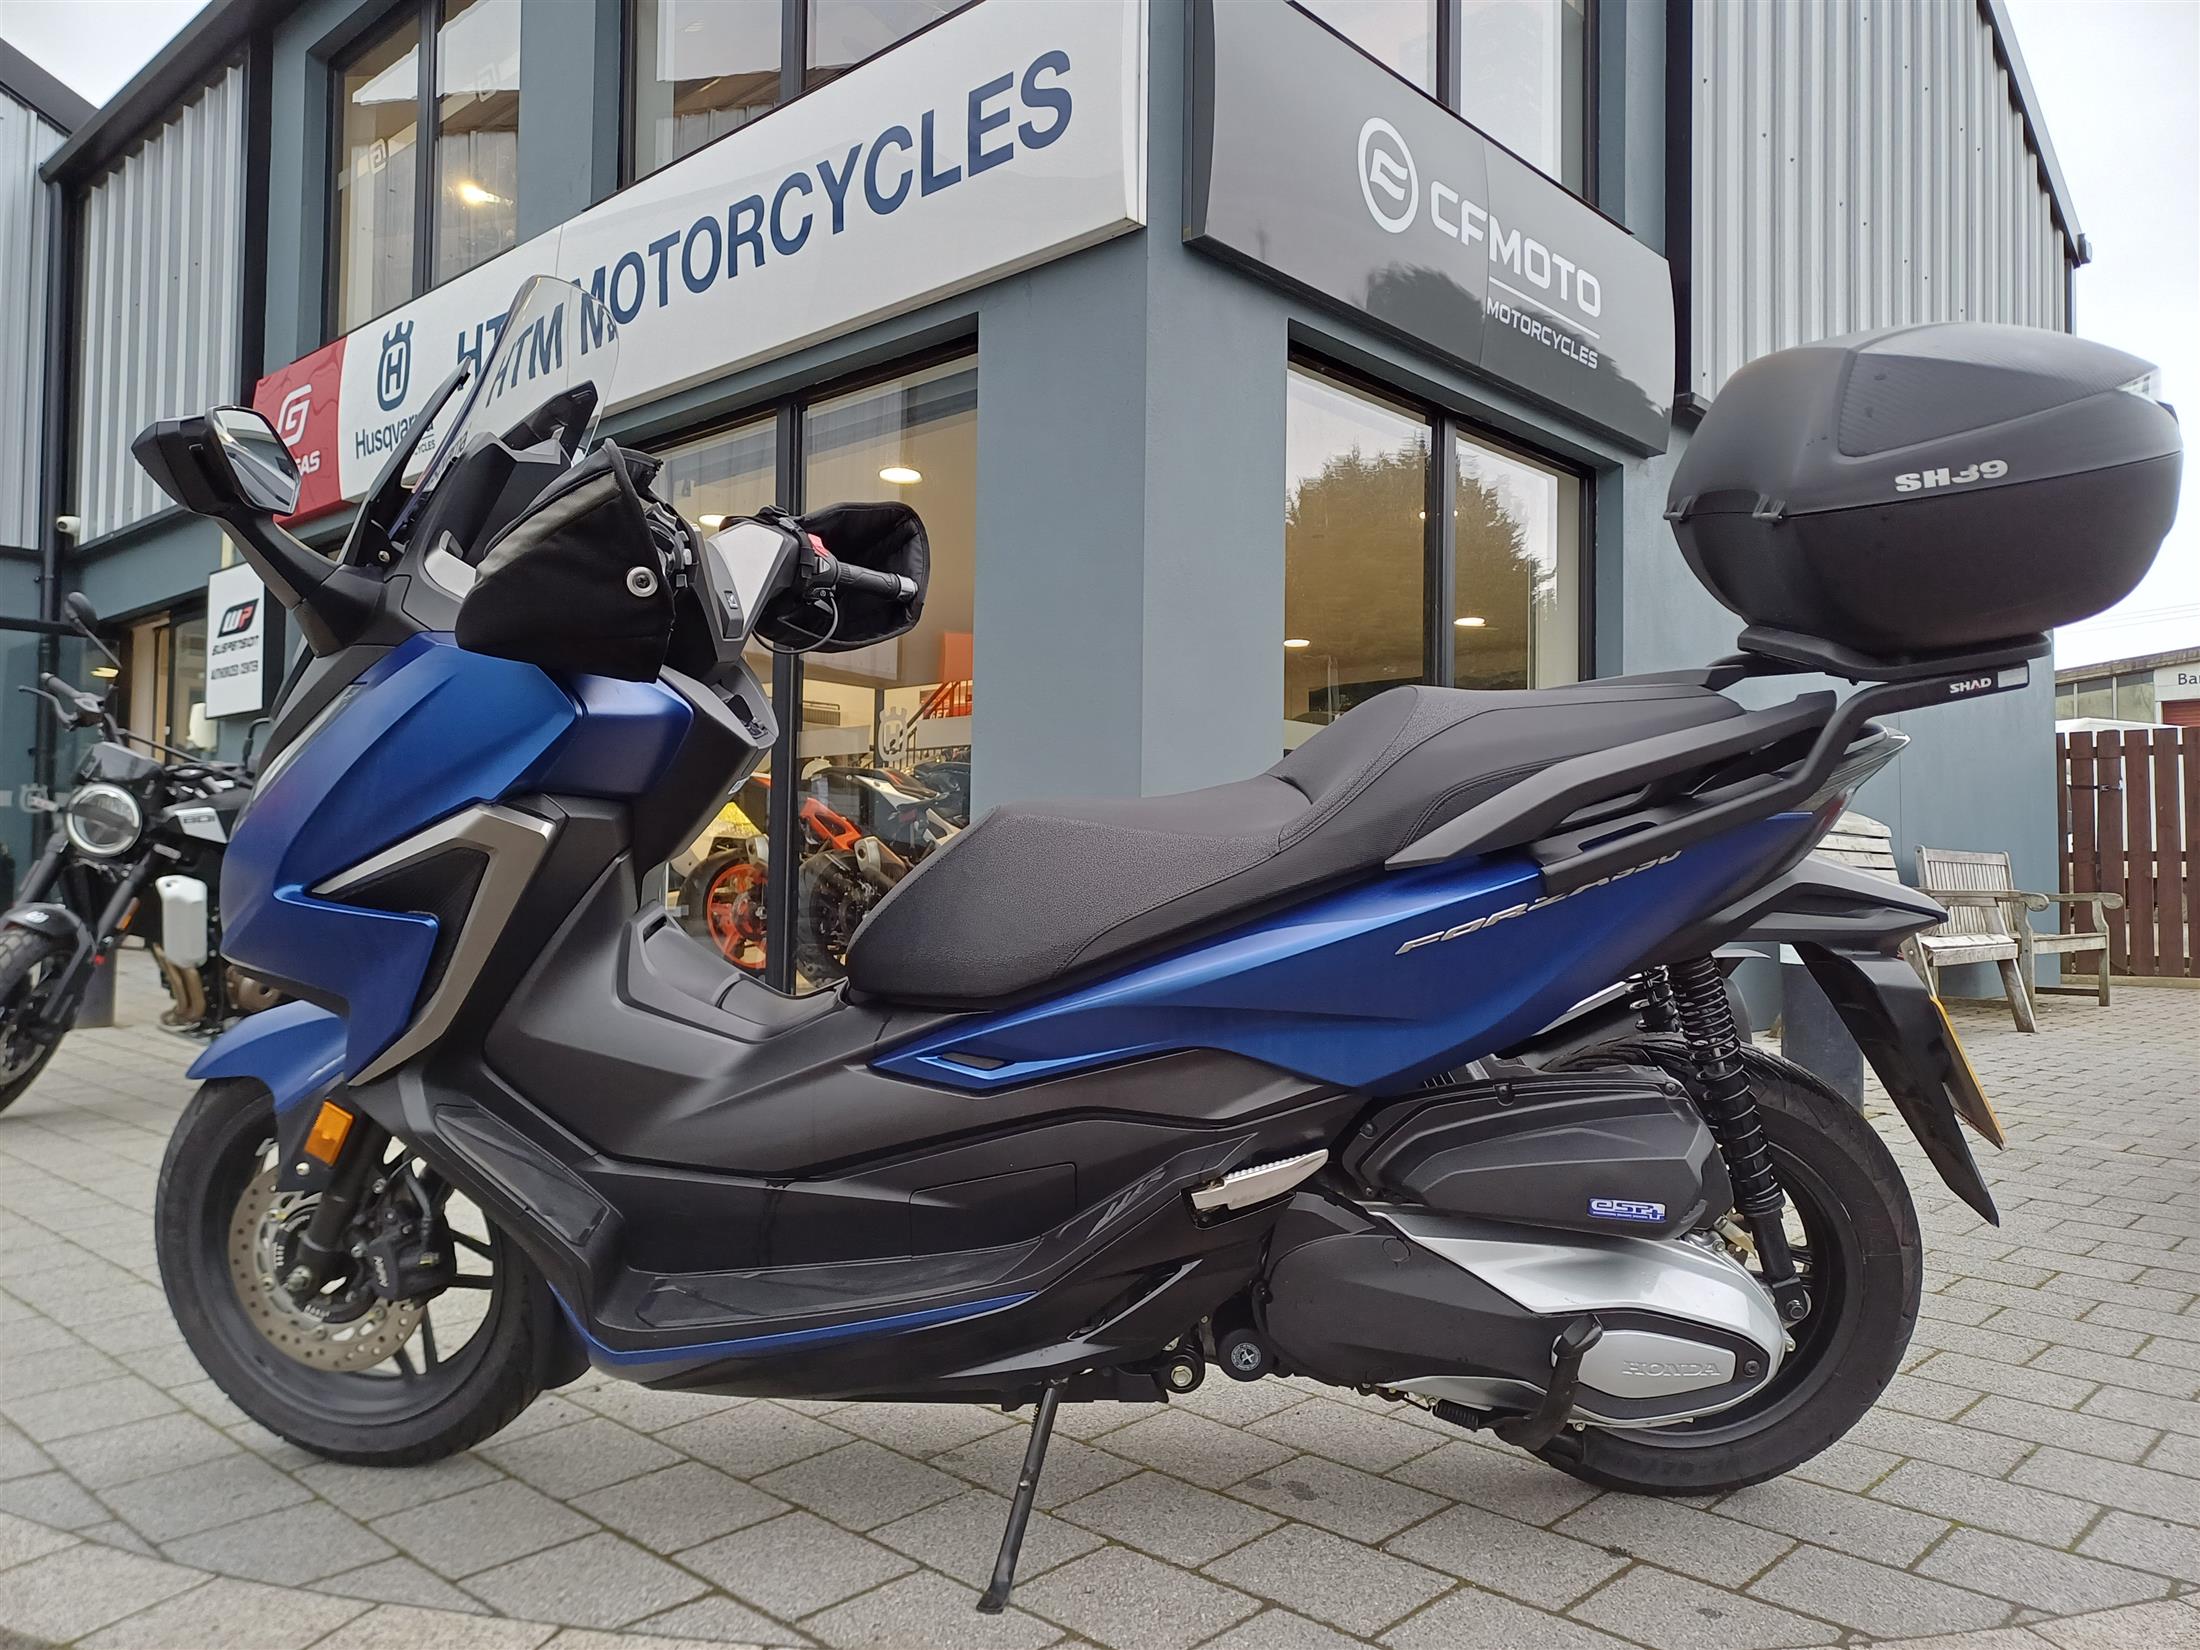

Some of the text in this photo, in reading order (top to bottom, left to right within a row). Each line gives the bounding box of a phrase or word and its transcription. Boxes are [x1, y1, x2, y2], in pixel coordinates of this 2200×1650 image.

[571, 49, 1073, 355] MOTORCYCLES
[1430, 180, 1601, 318] CFMOTO
[1486, 296, 1599, 369] MOTORCYCLES
[1894, 459, 2009, 492] SH39
[1949, 677, 1992, 694] SHAD
[2178, 673, 2200, 686] Ba
[1622, 1360, 1721, 1377] HONDA
